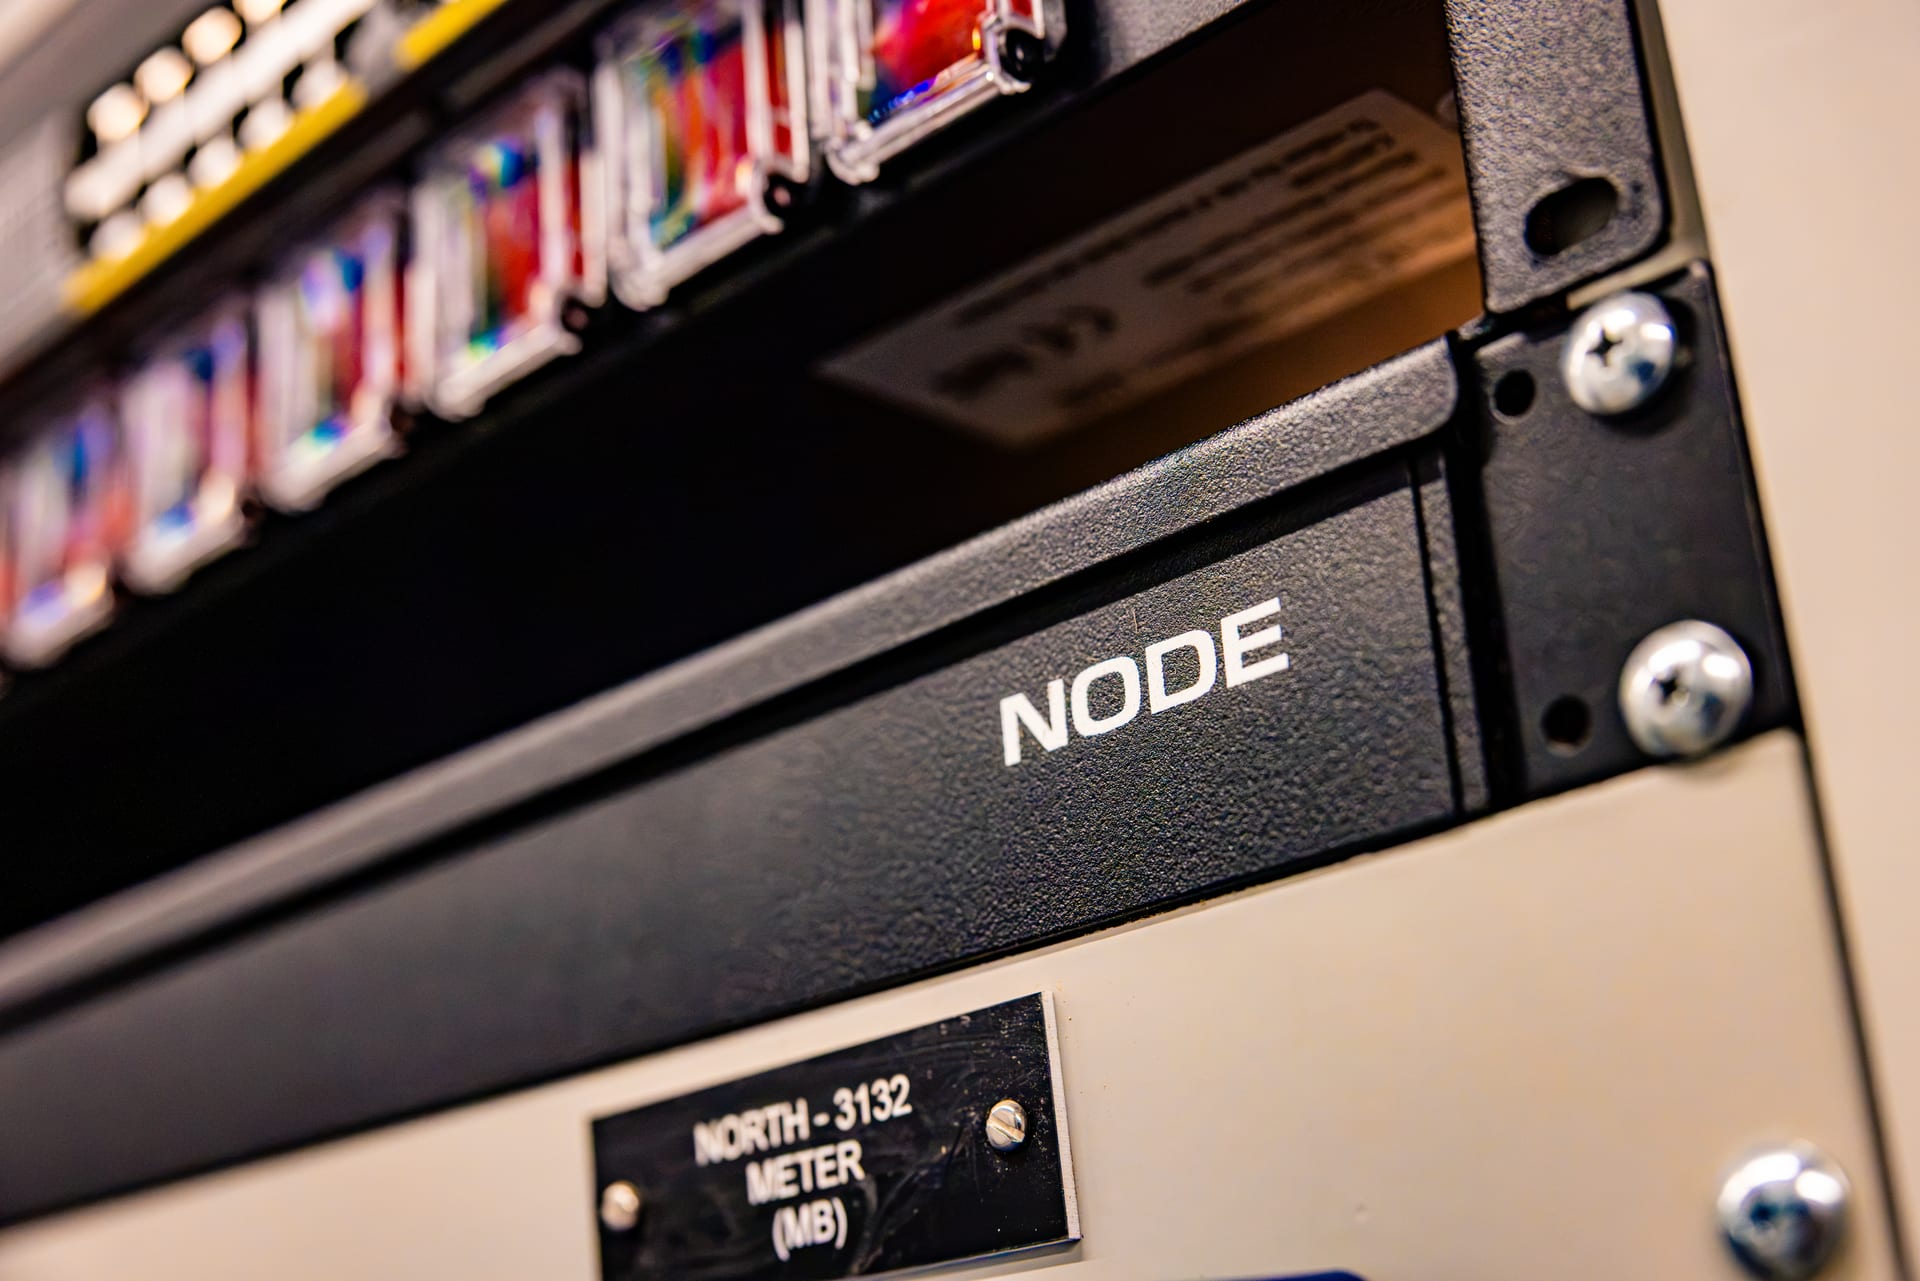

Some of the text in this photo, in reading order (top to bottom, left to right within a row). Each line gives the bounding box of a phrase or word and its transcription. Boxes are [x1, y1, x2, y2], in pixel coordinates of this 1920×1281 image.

[1000, 597, 1290, 766] NODE
[694, 1098, 809, 1166] NORTH
[833, 1074, 912, 1131] 3132
[745, 1139, 865, 1206] METER
[771, 1197, 848, 1262] (MB)
